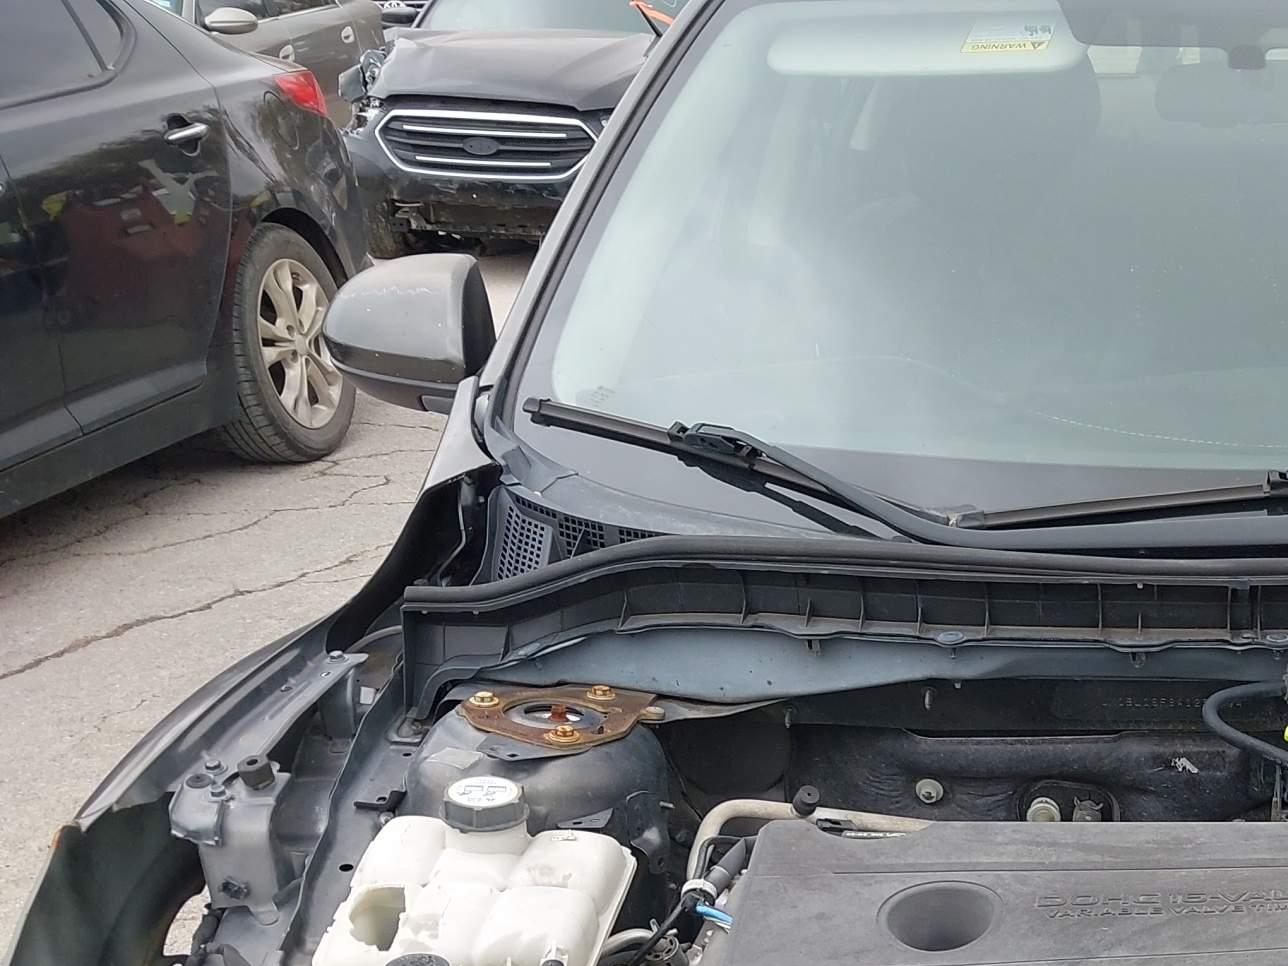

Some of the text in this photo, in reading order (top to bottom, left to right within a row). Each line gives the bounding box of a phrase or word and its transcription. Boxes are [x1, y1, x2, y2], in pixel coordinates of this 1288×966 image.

[971, 41, 1027, 51] WARNING
[1035, 892, 1161, 908] DOHC
[1046, 906, 1165, 919] VARIABLE
[1169, 904, 1246, 915] VALVE
